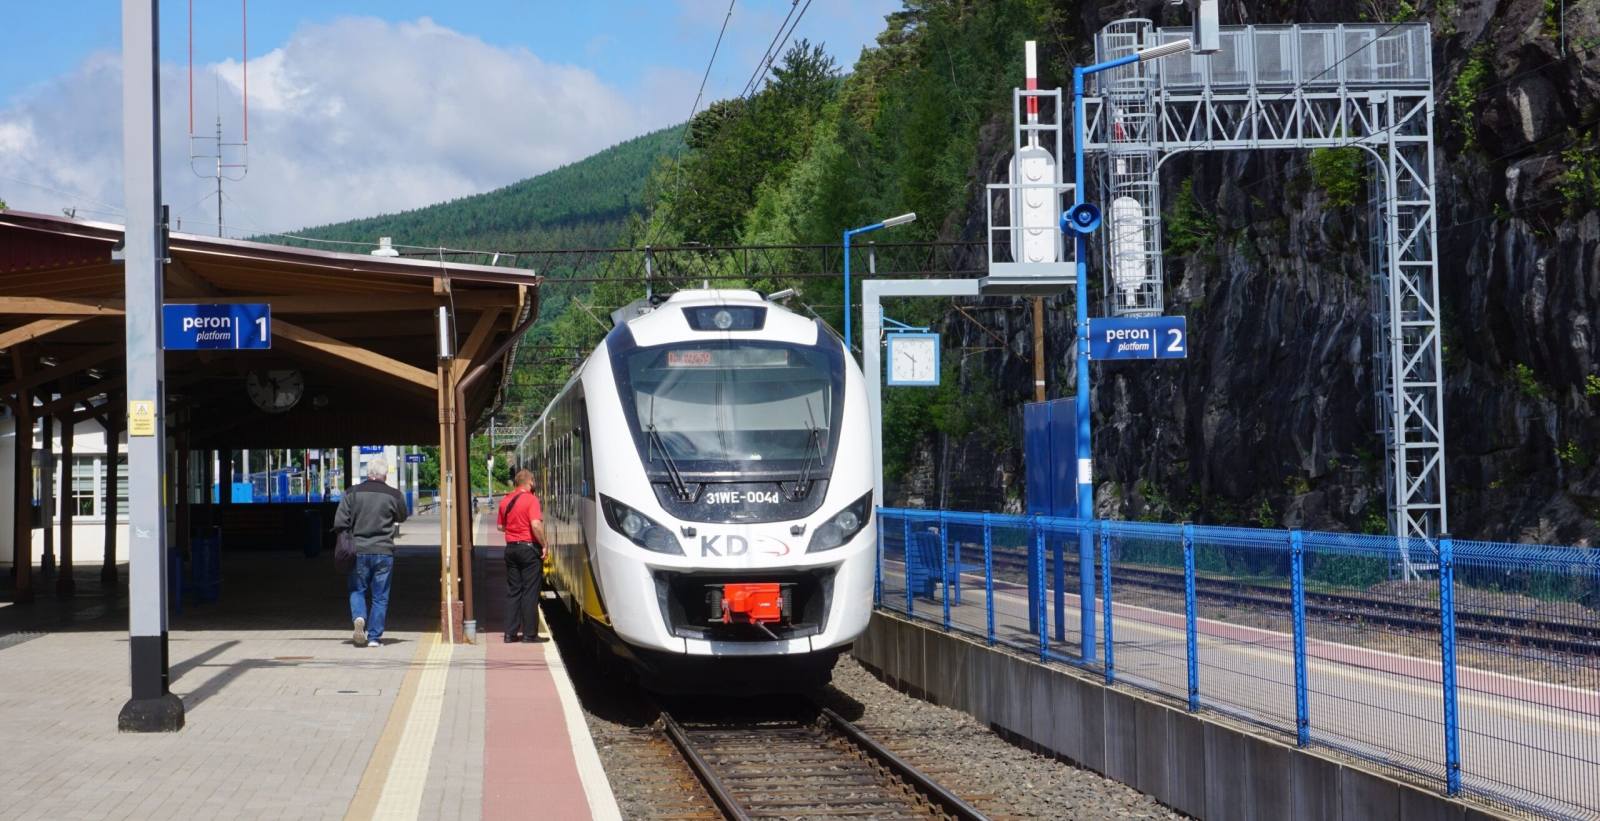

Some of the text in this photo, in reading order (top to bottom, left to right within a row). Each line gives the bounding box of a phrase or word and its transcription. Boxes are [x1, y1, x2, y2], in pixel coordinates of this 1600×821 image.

[183, 316, 267, 342] peron 1
[196, 330, 231, 342] platform
[1106, 328, 1184, 352] peron 2
[1117, 341, 1150, 353] platform
[706, 491, 779, 505] 31WE-004d
[701, 534, 748, 557] KD
